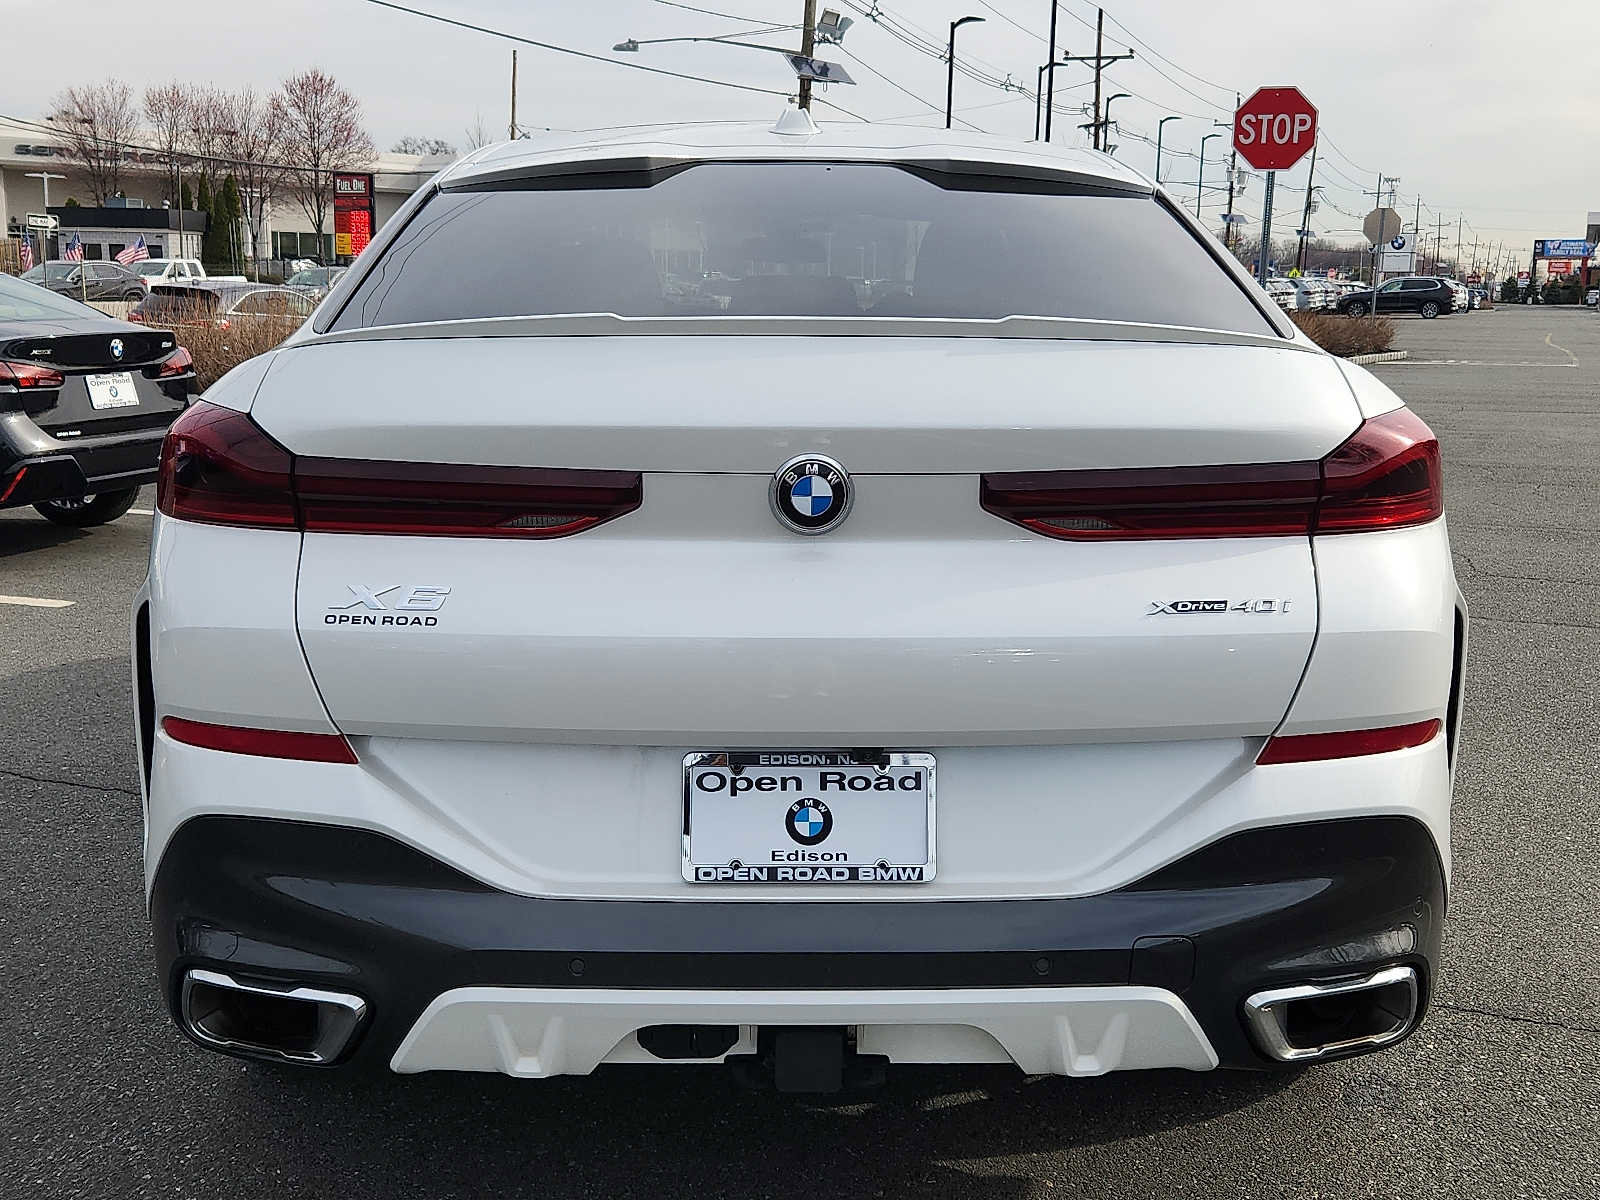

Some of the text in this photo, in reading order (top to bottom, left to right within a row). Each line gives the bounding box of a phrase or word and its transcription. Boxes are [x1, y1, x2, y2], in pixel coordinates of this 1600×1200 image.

[1239, 113, 1312, 145] STOP
[336, 179, 366, 191] FUEL ONE
[784, 463, 841, 486] BMW
[326, 584, 451, 611] X6
[324, 614, 438, 626] OPEN ROAD
[695, 771, 922, 798] Open Road
[791, 799, 828, 813] BMW
[770, 849, 849, 862] Edison
[697, 866, 921, 881] OPEN ROAD BMW
